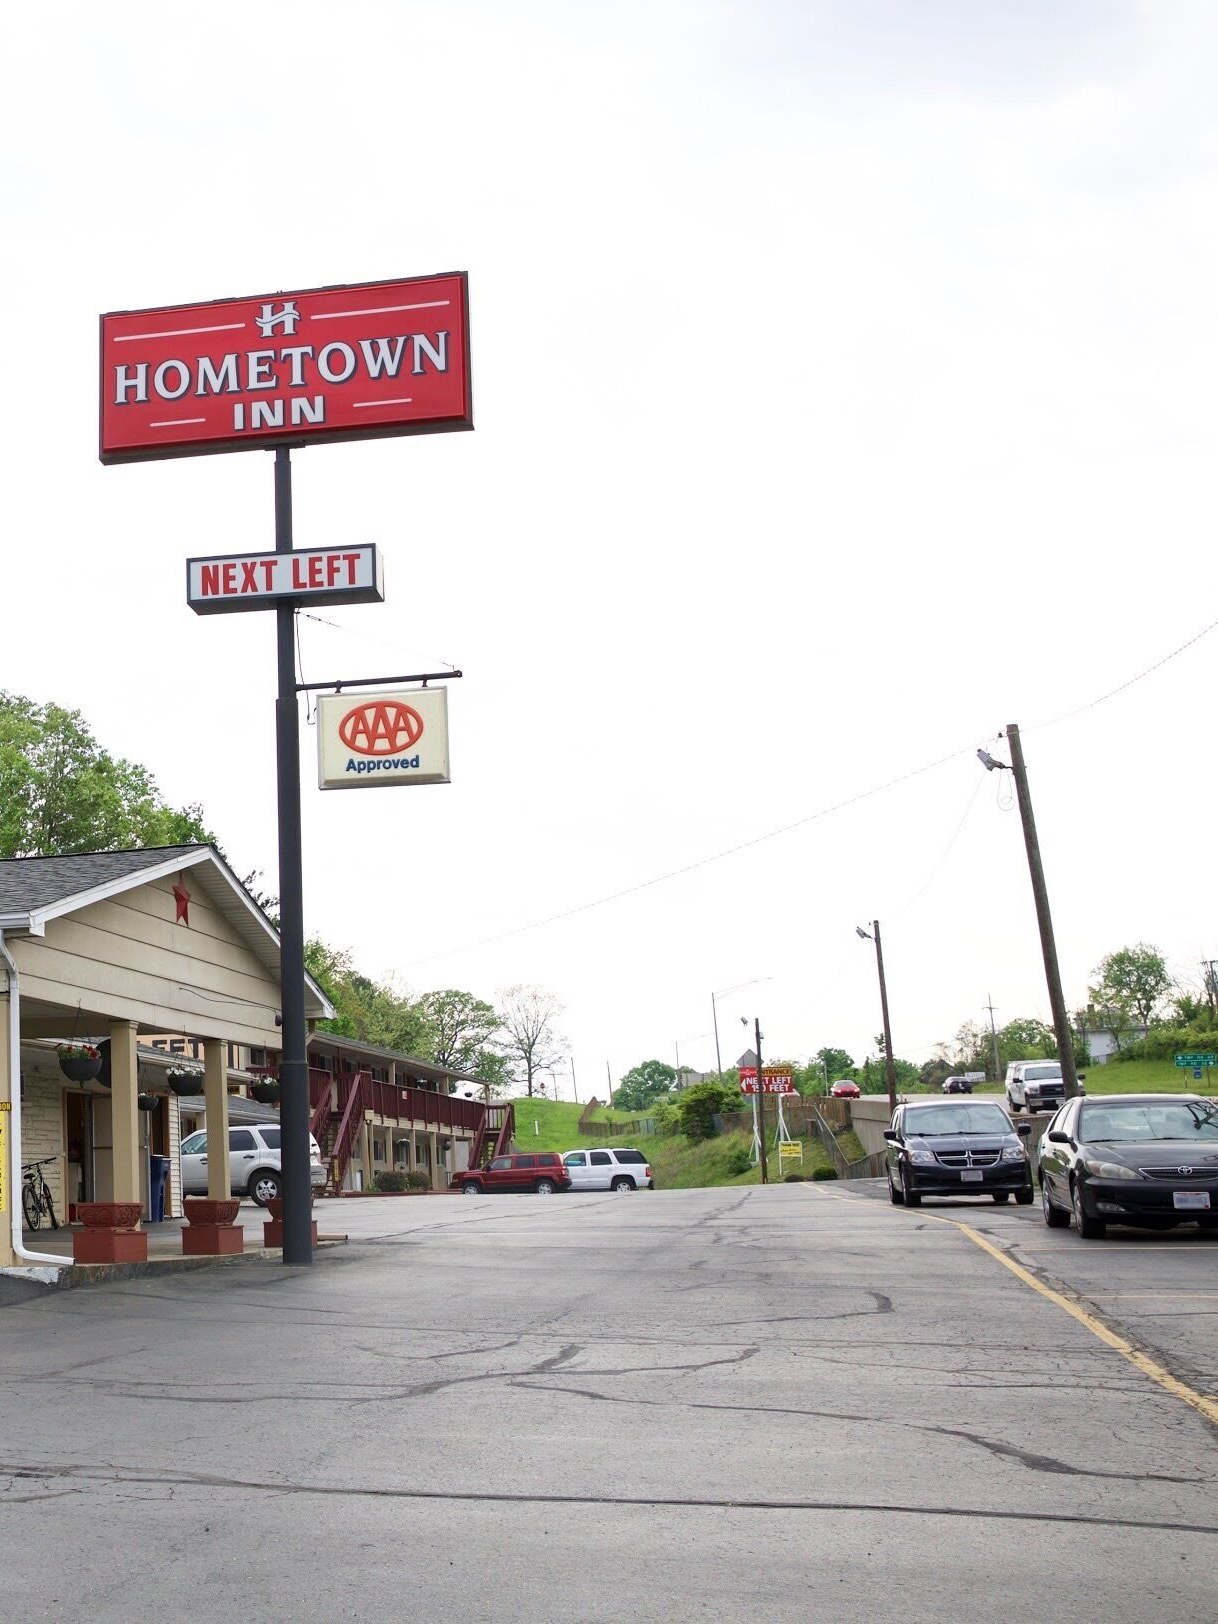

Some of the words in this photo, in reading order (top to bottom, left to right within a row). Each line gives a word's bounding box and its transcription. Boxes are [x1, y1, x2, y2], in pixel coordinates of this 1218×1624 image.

[114, 331, 449, 405] HOMETOWN
[233, 396, 325, 431] INN
[201, 560, 278, 596] NEXT
[292, 553, 361, 590] LEFT
[345, 703, 419, 754] AAA
[345, 755, 420, 773] Approved
[769, 1084, 790, 1092] FEET
[771, 1076, 792, 1084] LEFT
